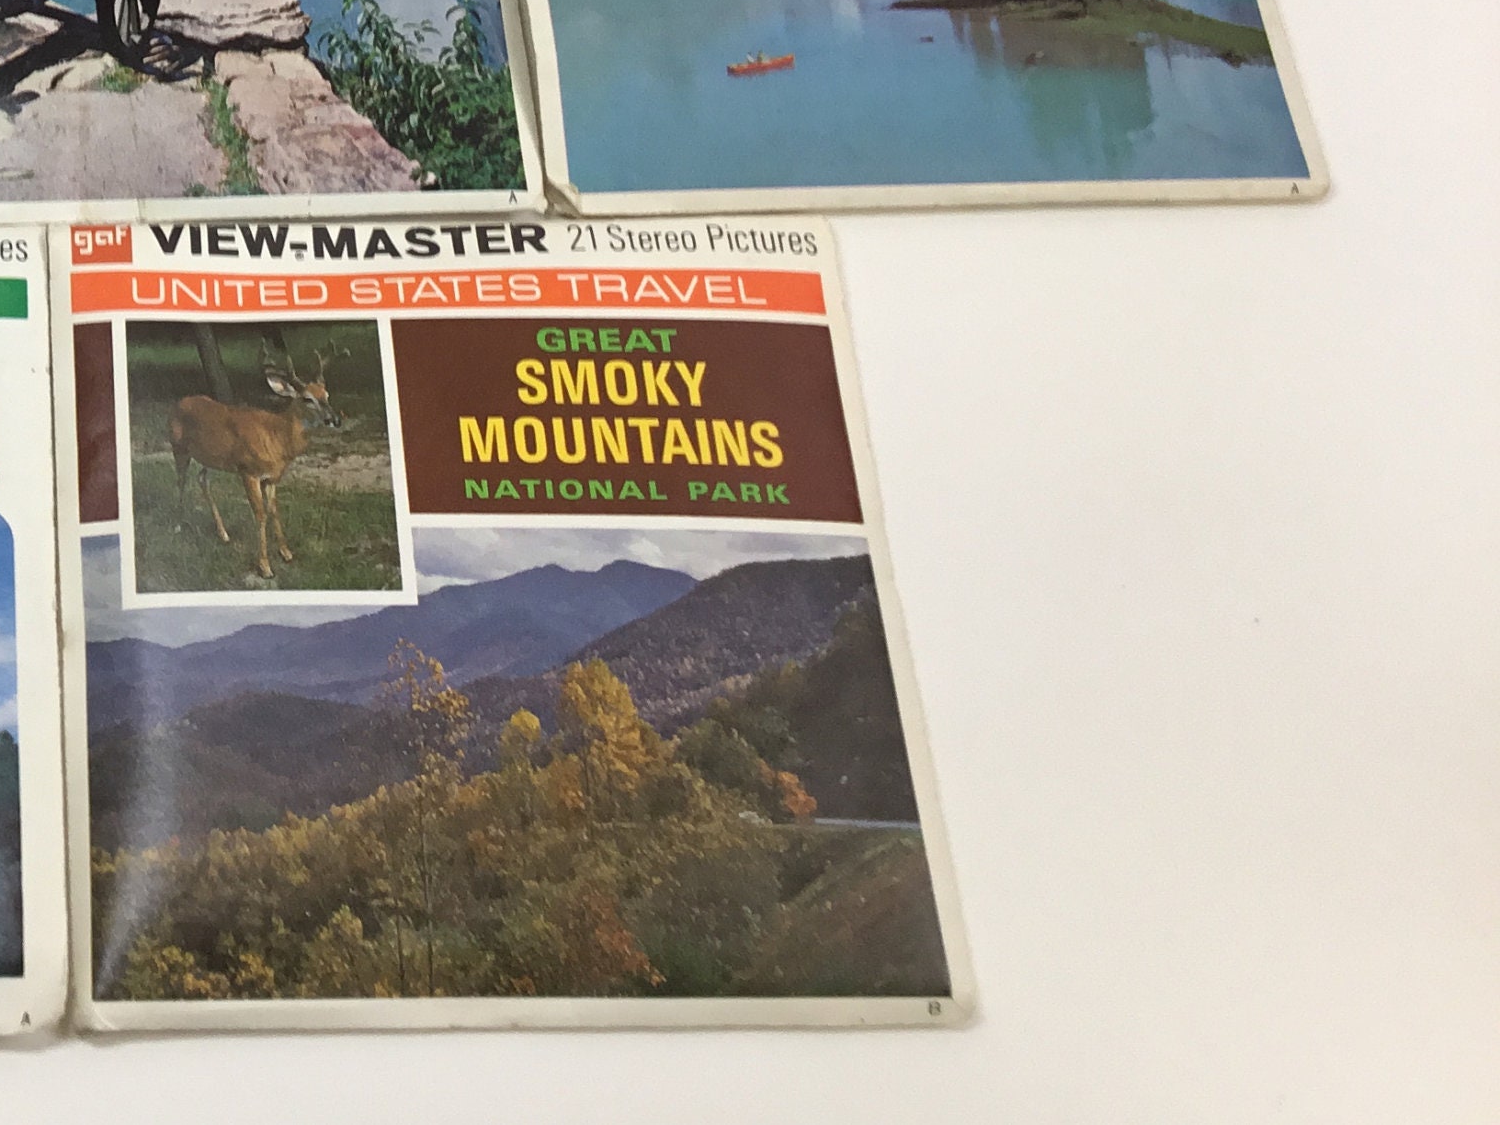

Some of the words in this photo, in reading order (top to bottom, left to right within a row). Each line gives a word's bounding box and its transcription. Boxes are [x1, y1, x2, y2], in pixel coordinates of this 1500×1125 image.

[508, 189, 518, 204] A
[1291, 182, 1300, 194] A
[74, 225, 130, 255] gaf
[150, 223, 550, 260] VIEW-MASTER
[566, 224, 597, 252] 21
[607, 225, 698, 253] Stereo
[706, 224, 819, 256] Pictures
[132, 277, 327, 307] UNITED
[350, 274, 542, 305] STATES
[558, 274, 767, 305] TRAVEL
[536, 327, 677, 353] GREAT
[515, 358, 706, 407] SMOKY
[459, 416, 784, 468] MOUNTAINS
[463, 479, 668, 501] NATIONAL
[688, 481, 791, 505] PARK
[20, 1011, 31, 1026] A
